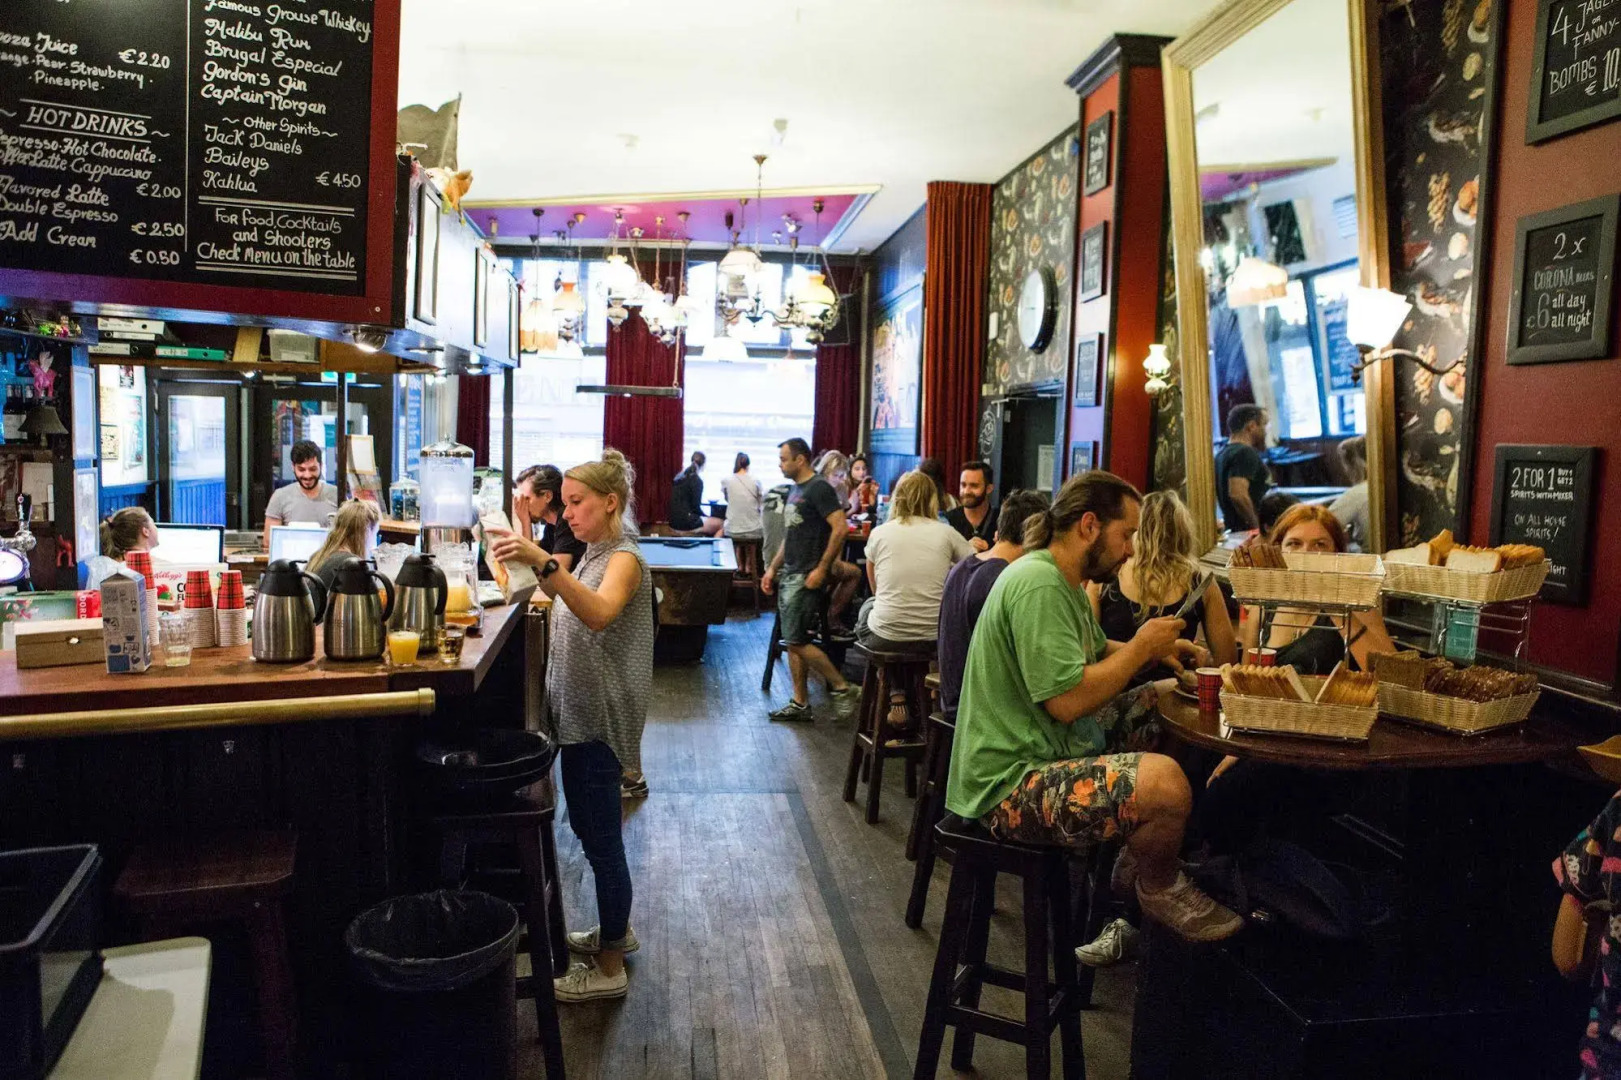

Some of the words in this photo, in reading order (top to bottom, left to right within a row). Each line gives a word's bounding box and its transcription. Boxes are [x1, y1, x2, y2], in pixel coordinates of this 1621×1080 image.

[204, 18, 263, 42] Malibu
[265, 5, 318, 25] Grouse
[319, 9, 371, 43] Whiskey
[1551, 6, 1573, 46] 4
[34, 31, 79, 56] Juice
[204, 39, 267, 67] Brugal
[271, 51, 343, 77] Especial
[34, 70, 101, 91] Pineapple
[69, 60, 145, 89] Strawberry
[202, 60, 271, 87] Gordon's
[278, 74, 308, 96] Gin
[1549, 56, 1598, 95] BOMBS
[200, 83, 265, 105] Captain
[264, 90, 327, 118] Morgan
[26, 105, 71, 129] HOT
[71, 110, 148, 138] DRINKS
[243, 116, 278, 132] Other
[279, 118, 321, 138] Spirits
[0, 131, 59, 151] spresso
[60, 136, 89, 157] Hot
[91, 141, 157, 163] Chocolate
[204, 124, 246, 146] Jack
[249, 132, 304, 155] Daniels
[70, 158, 152, 183] Cappuccino
[204, 146, 270, 178] Baileys
[202, 170, 258, 193] Kahlua
[65, 184, 110, 207] Latte
[51, 201, 119, 224] Espresso
[276, 213, 342, 234] Cocktails
[47, 225, 97, 248] Cream
[232, 228, 259, 243] and
[264, 230, 332, 251] Shooters
[1553, 232, 1567, 260] 2
[197, 242, 242, 261] Check
[244, 246, 282, 265] Menu
[284, 251, 301, 266] on
[302, 248, 322, 267] the
[323, 249, 356, 269] table
[1533, 266, 1575, 291] CORONA
[1552, 294, 1565, 308] all
[1567, 294, 1587, 312] day
[1551, 312, 1565, 328] all
[1567, 309, 1592, 333] night
[1511, 467, 1521, 488] 2
[1523, 468, 1545, 489] FOR
[1547, 467, 1555, 490] 1
[1527, 513, 1541, 526] ALL
[1550, 563, 1567, 576] IGHT
